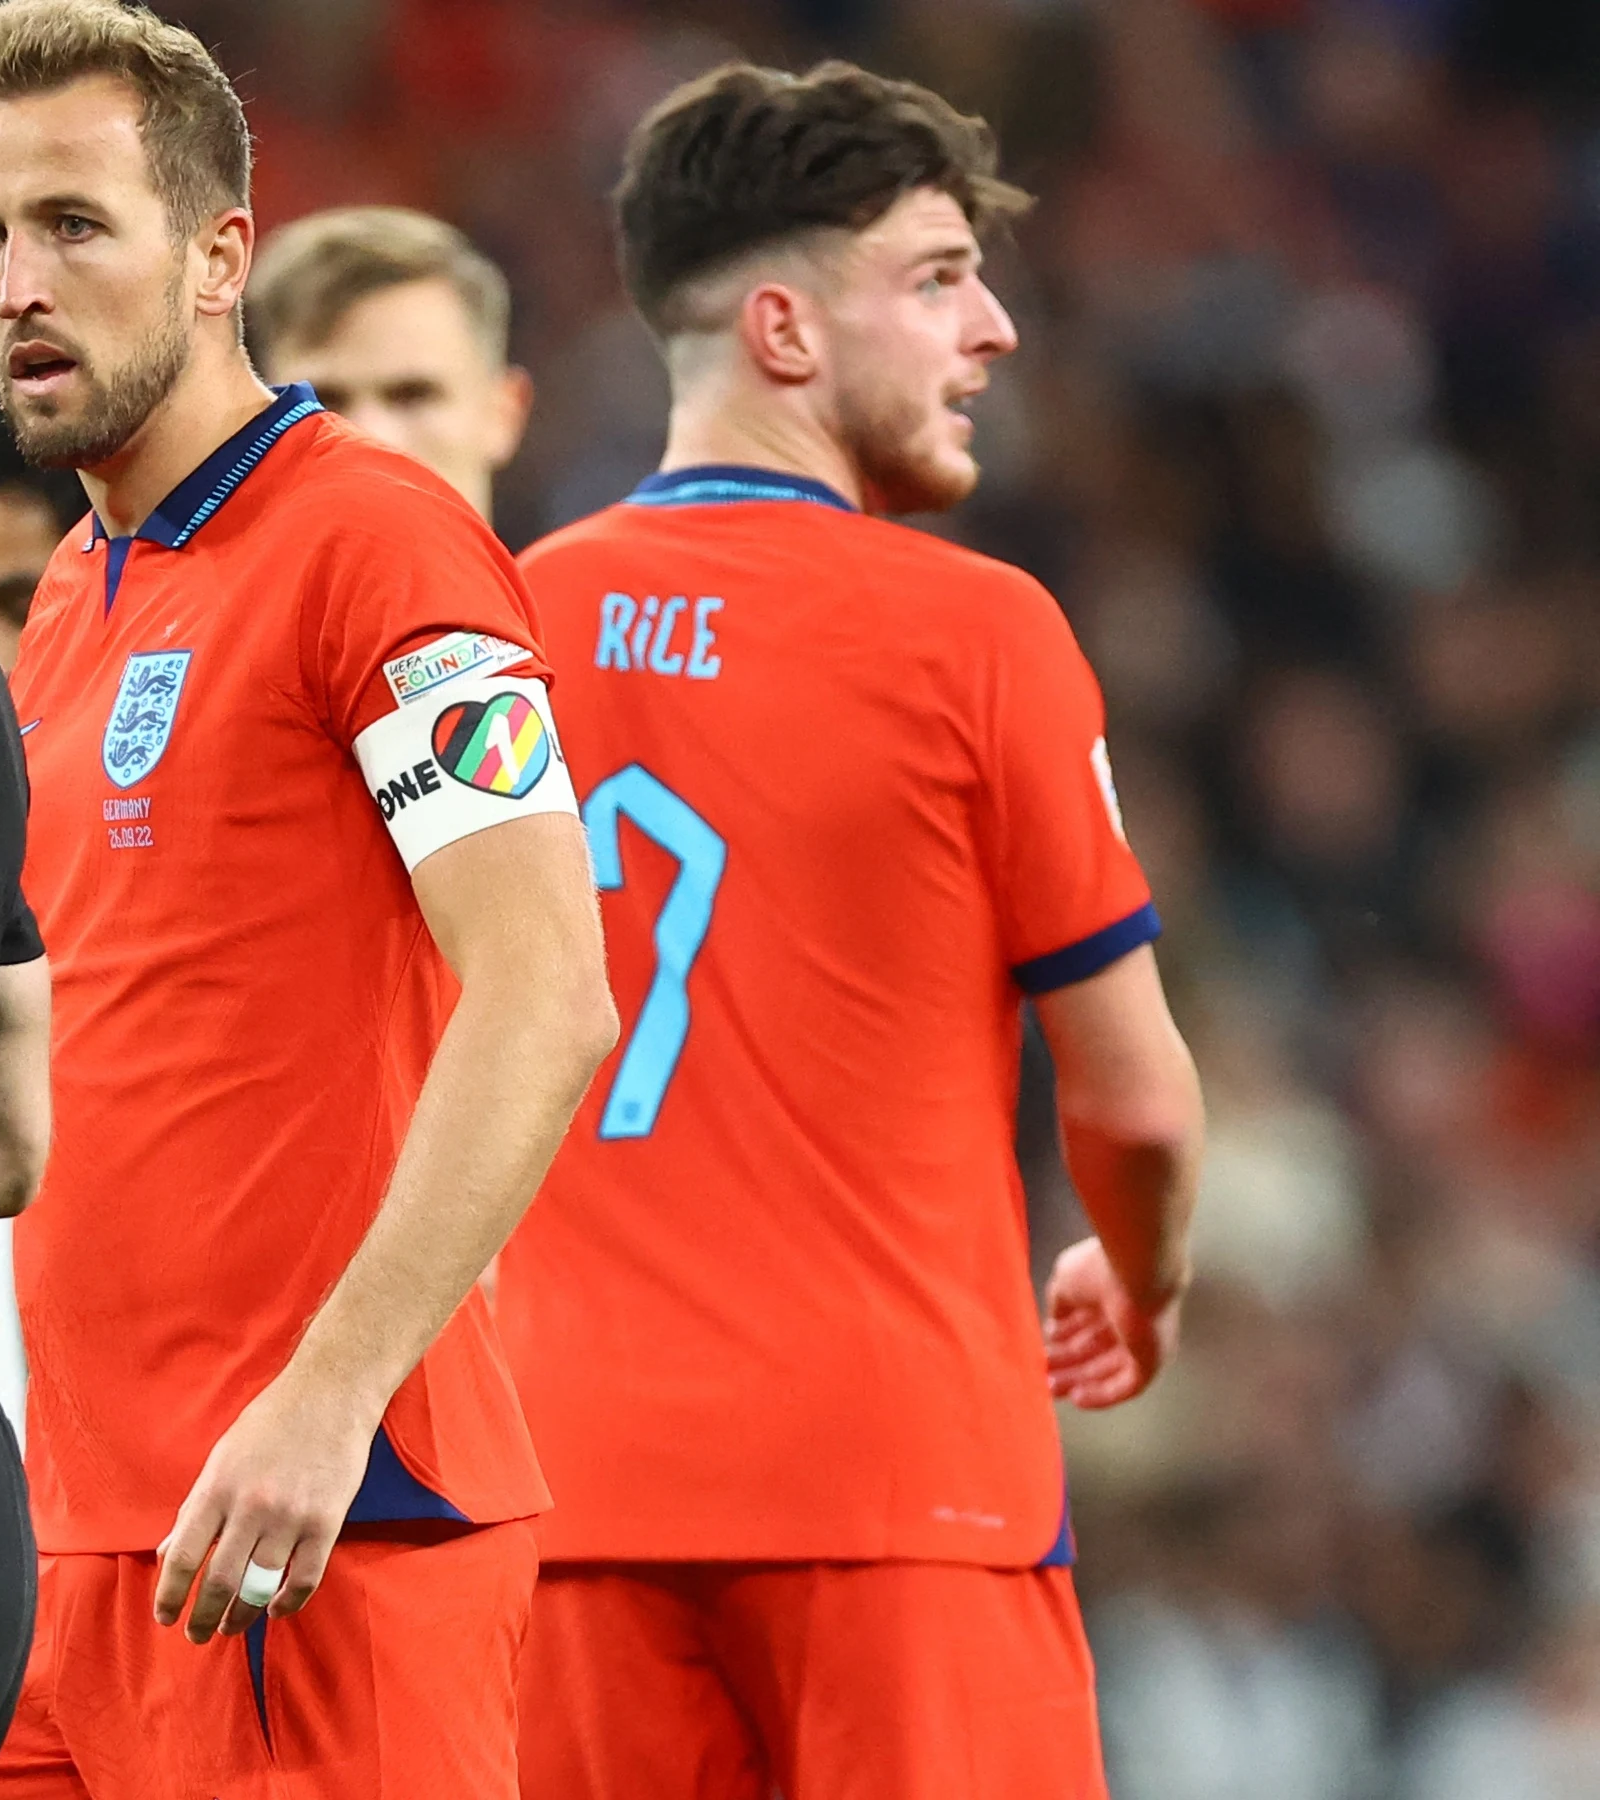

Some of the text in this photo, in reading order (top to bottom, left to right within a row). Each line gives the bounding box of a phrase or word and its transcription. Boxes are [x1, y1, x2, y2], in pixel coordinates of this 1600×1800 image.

[390, 655, 422, 676] UEFA
[103, 797, 151, 821] GERMANY
[377, 758, 442, 822] ONE
[583, 762, 727, 1139] 7
